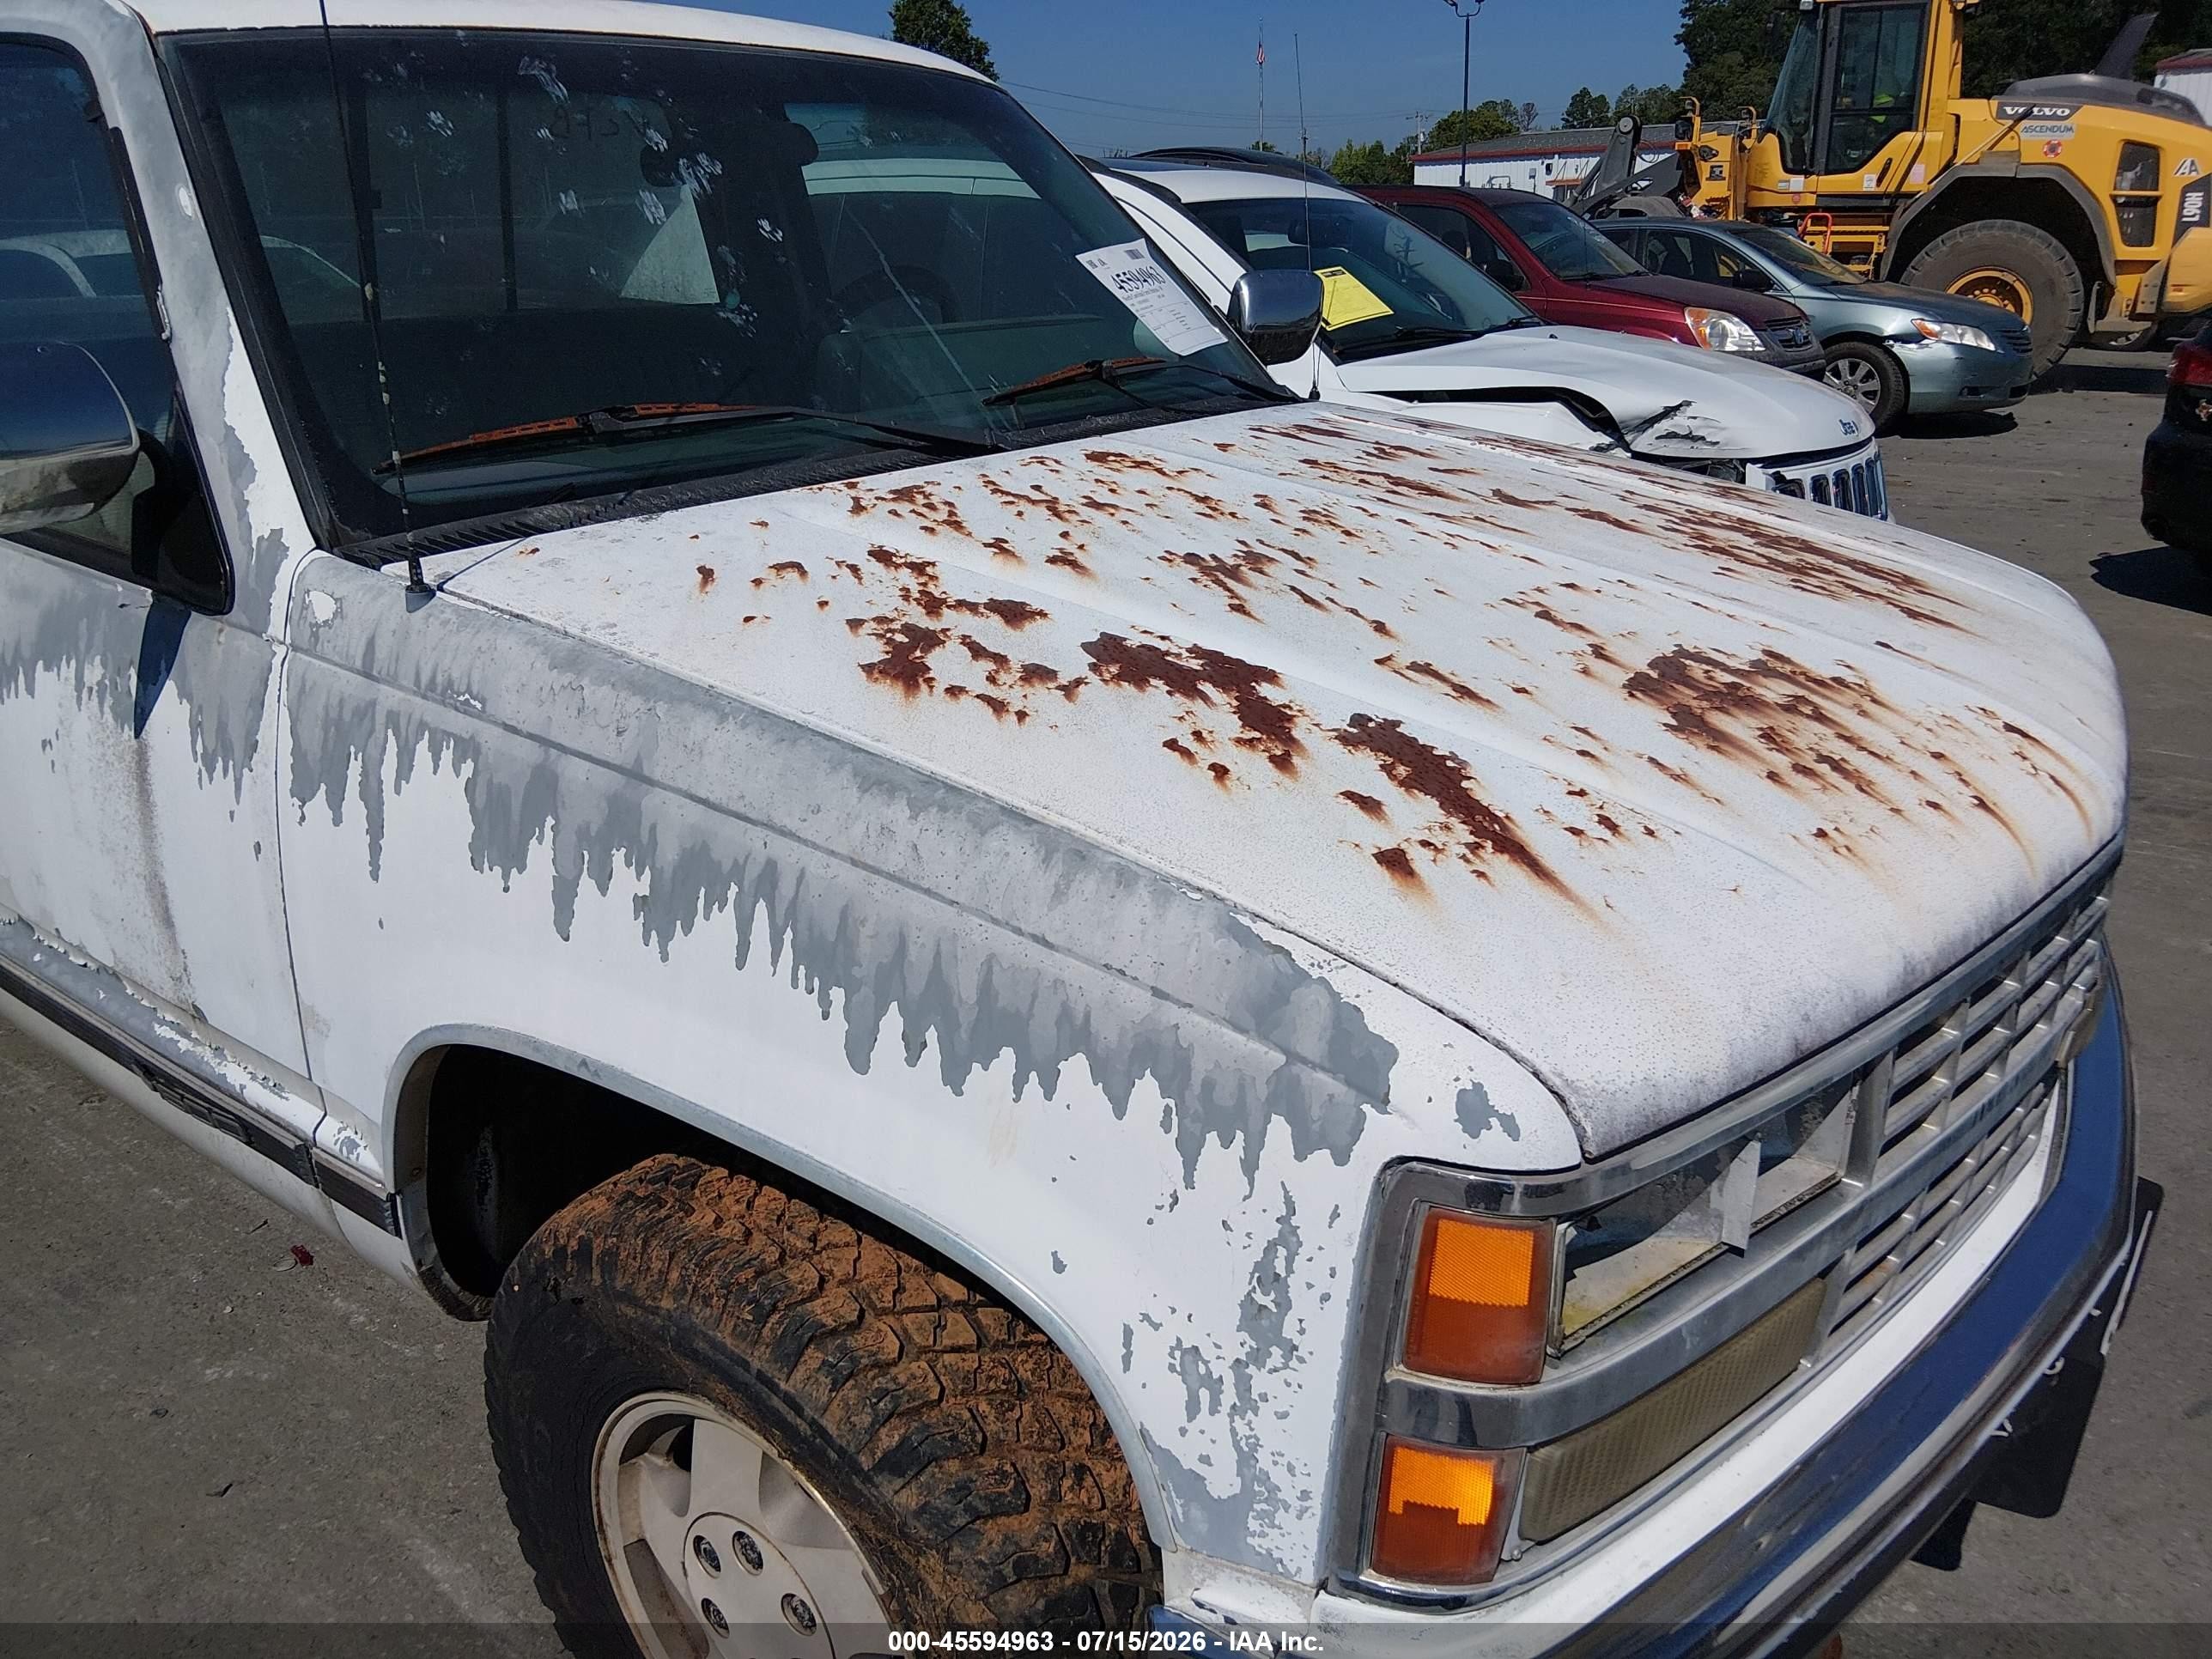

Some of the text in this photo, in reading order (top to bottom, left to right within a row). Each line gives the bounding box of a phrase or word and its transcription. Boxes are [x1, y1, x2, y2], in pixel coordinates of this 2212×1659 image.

[2021, 125, 2075, 133] ASCENDUM
[2181, 192, 2204, 222] L90H
[1110, 265, 1166, 293] 45594963
